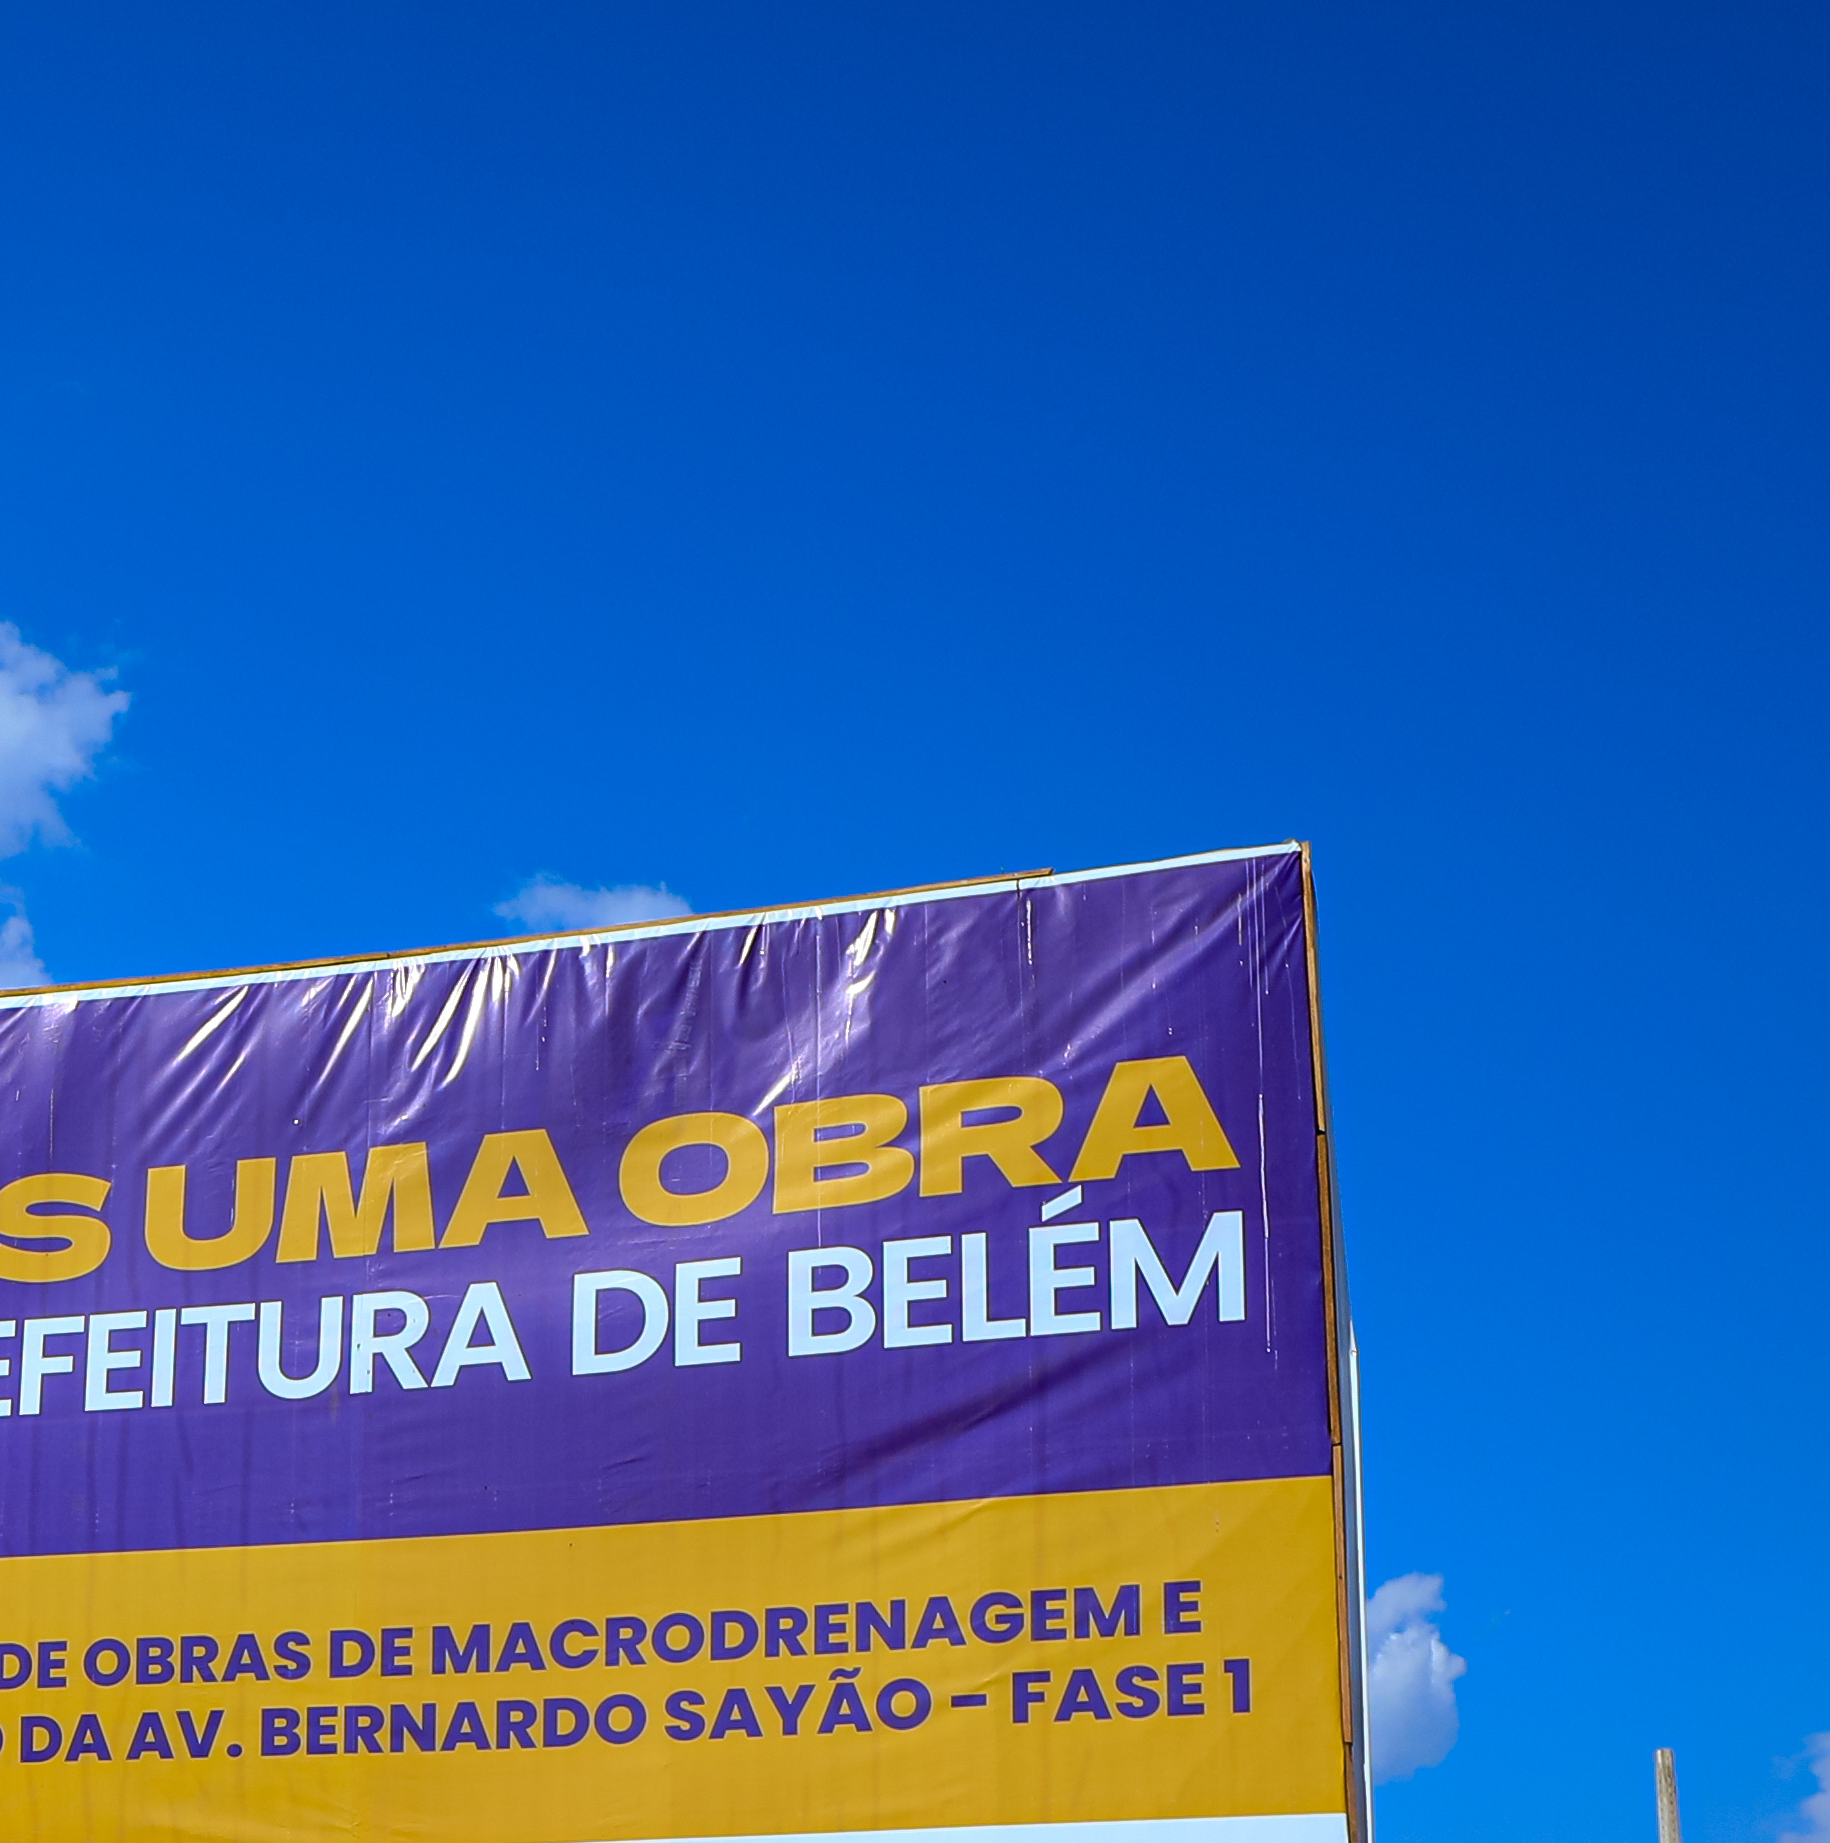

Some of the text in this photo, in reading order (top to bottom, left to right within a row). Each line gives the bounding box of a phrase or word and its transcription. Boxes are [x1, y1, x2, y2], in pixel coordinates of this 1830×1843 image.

[146, 1129, 588, 1269] UMA
[620, 1056, 1240, 1225] OBRA
[573, 1257, 740, 1375] DE
[787, 1185, 1246, 1356] BELÉM
[86, 1631, 310, 1686] OBRAS
[332, 1627, 412, 1677] DE
[434, 1585, 1140, 1679] MACRODRENAGEM
[1166, 1581, 1201, 1633] E
[22, 1715, 110, 1762] DA
[129, 1710, 242, 1759] AV.
[262, 1694, 646, 1755] BERNARDO
[667, 1668, 932, 1740] SAYÃO
[1014, 1663, 1204, 1722] FASE
[1226, 1659, 1250, 1712] 1
